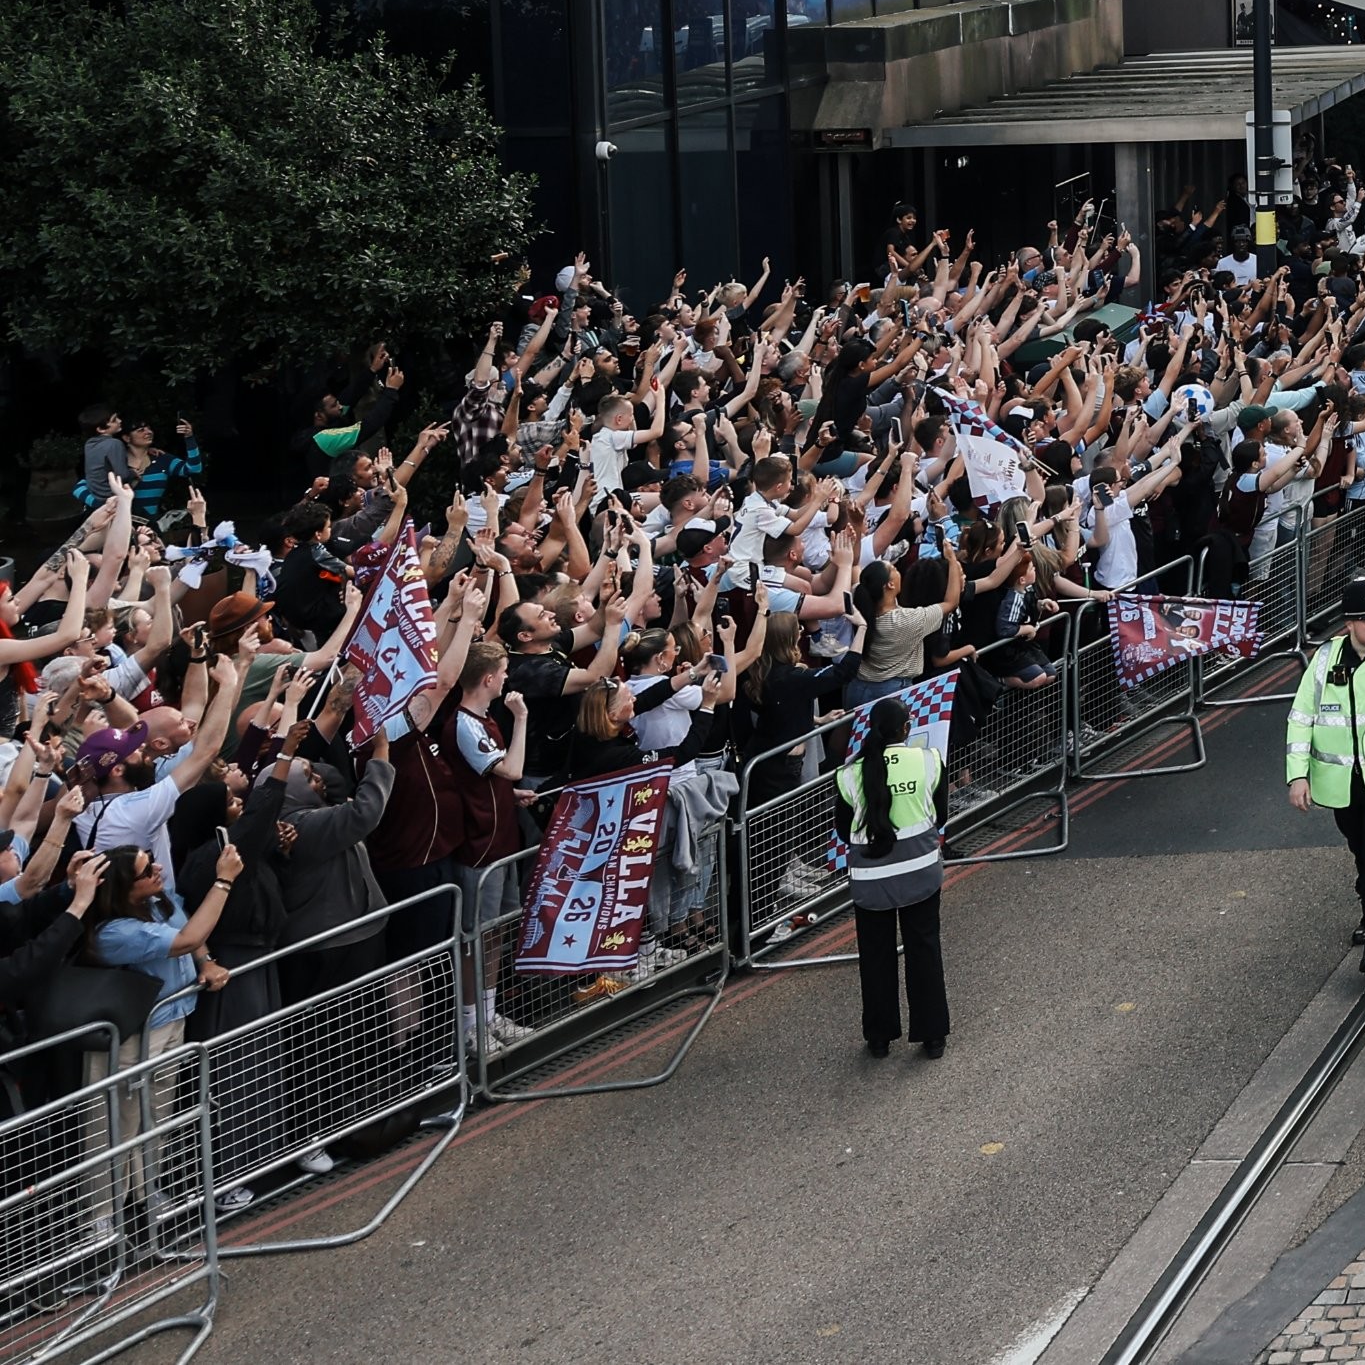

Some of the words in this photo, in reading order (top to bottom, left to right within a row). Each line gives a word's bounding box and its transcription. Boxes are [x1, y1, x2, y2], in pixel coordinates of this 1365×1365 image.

[888, 781, 917, 794] nsg
[593, 822, 616, 854] 20
[564, 896, 596, 922] 26
[597, 874, 616, 930] CHAMPIONS
